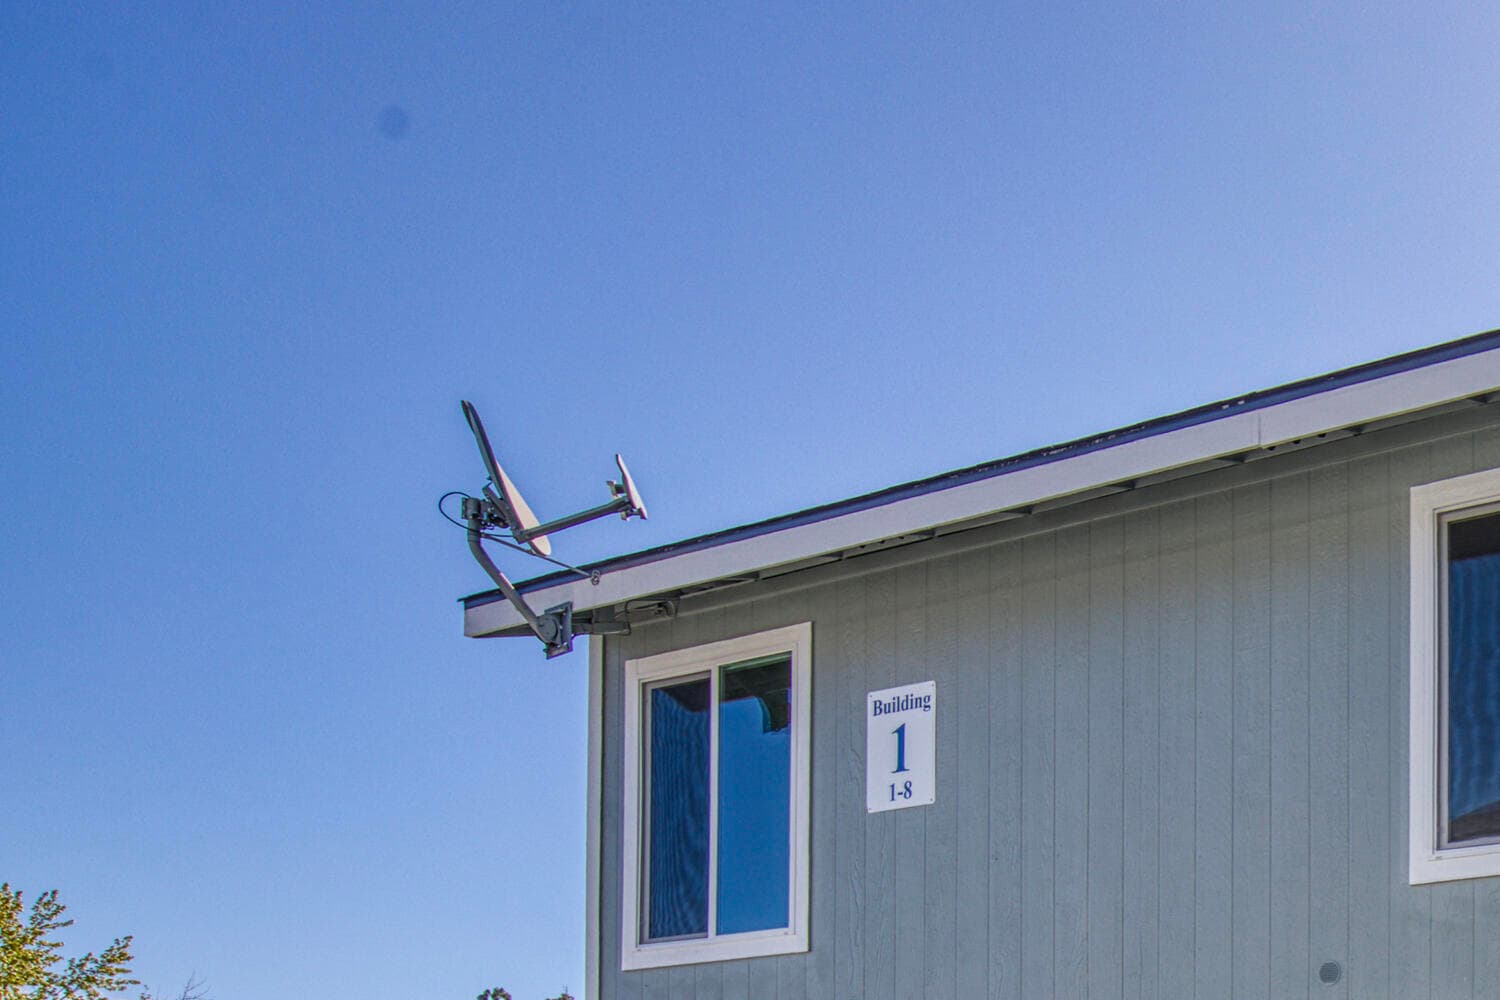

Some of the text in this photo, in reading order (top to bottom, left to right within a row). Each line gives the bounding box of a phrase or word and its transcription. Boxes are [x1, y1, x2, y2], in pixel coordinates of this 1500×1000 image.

[873, 694, 931, 716] Building
[891, 723, 910, 774] 1
[889, 780, 913, 801] 1-8
